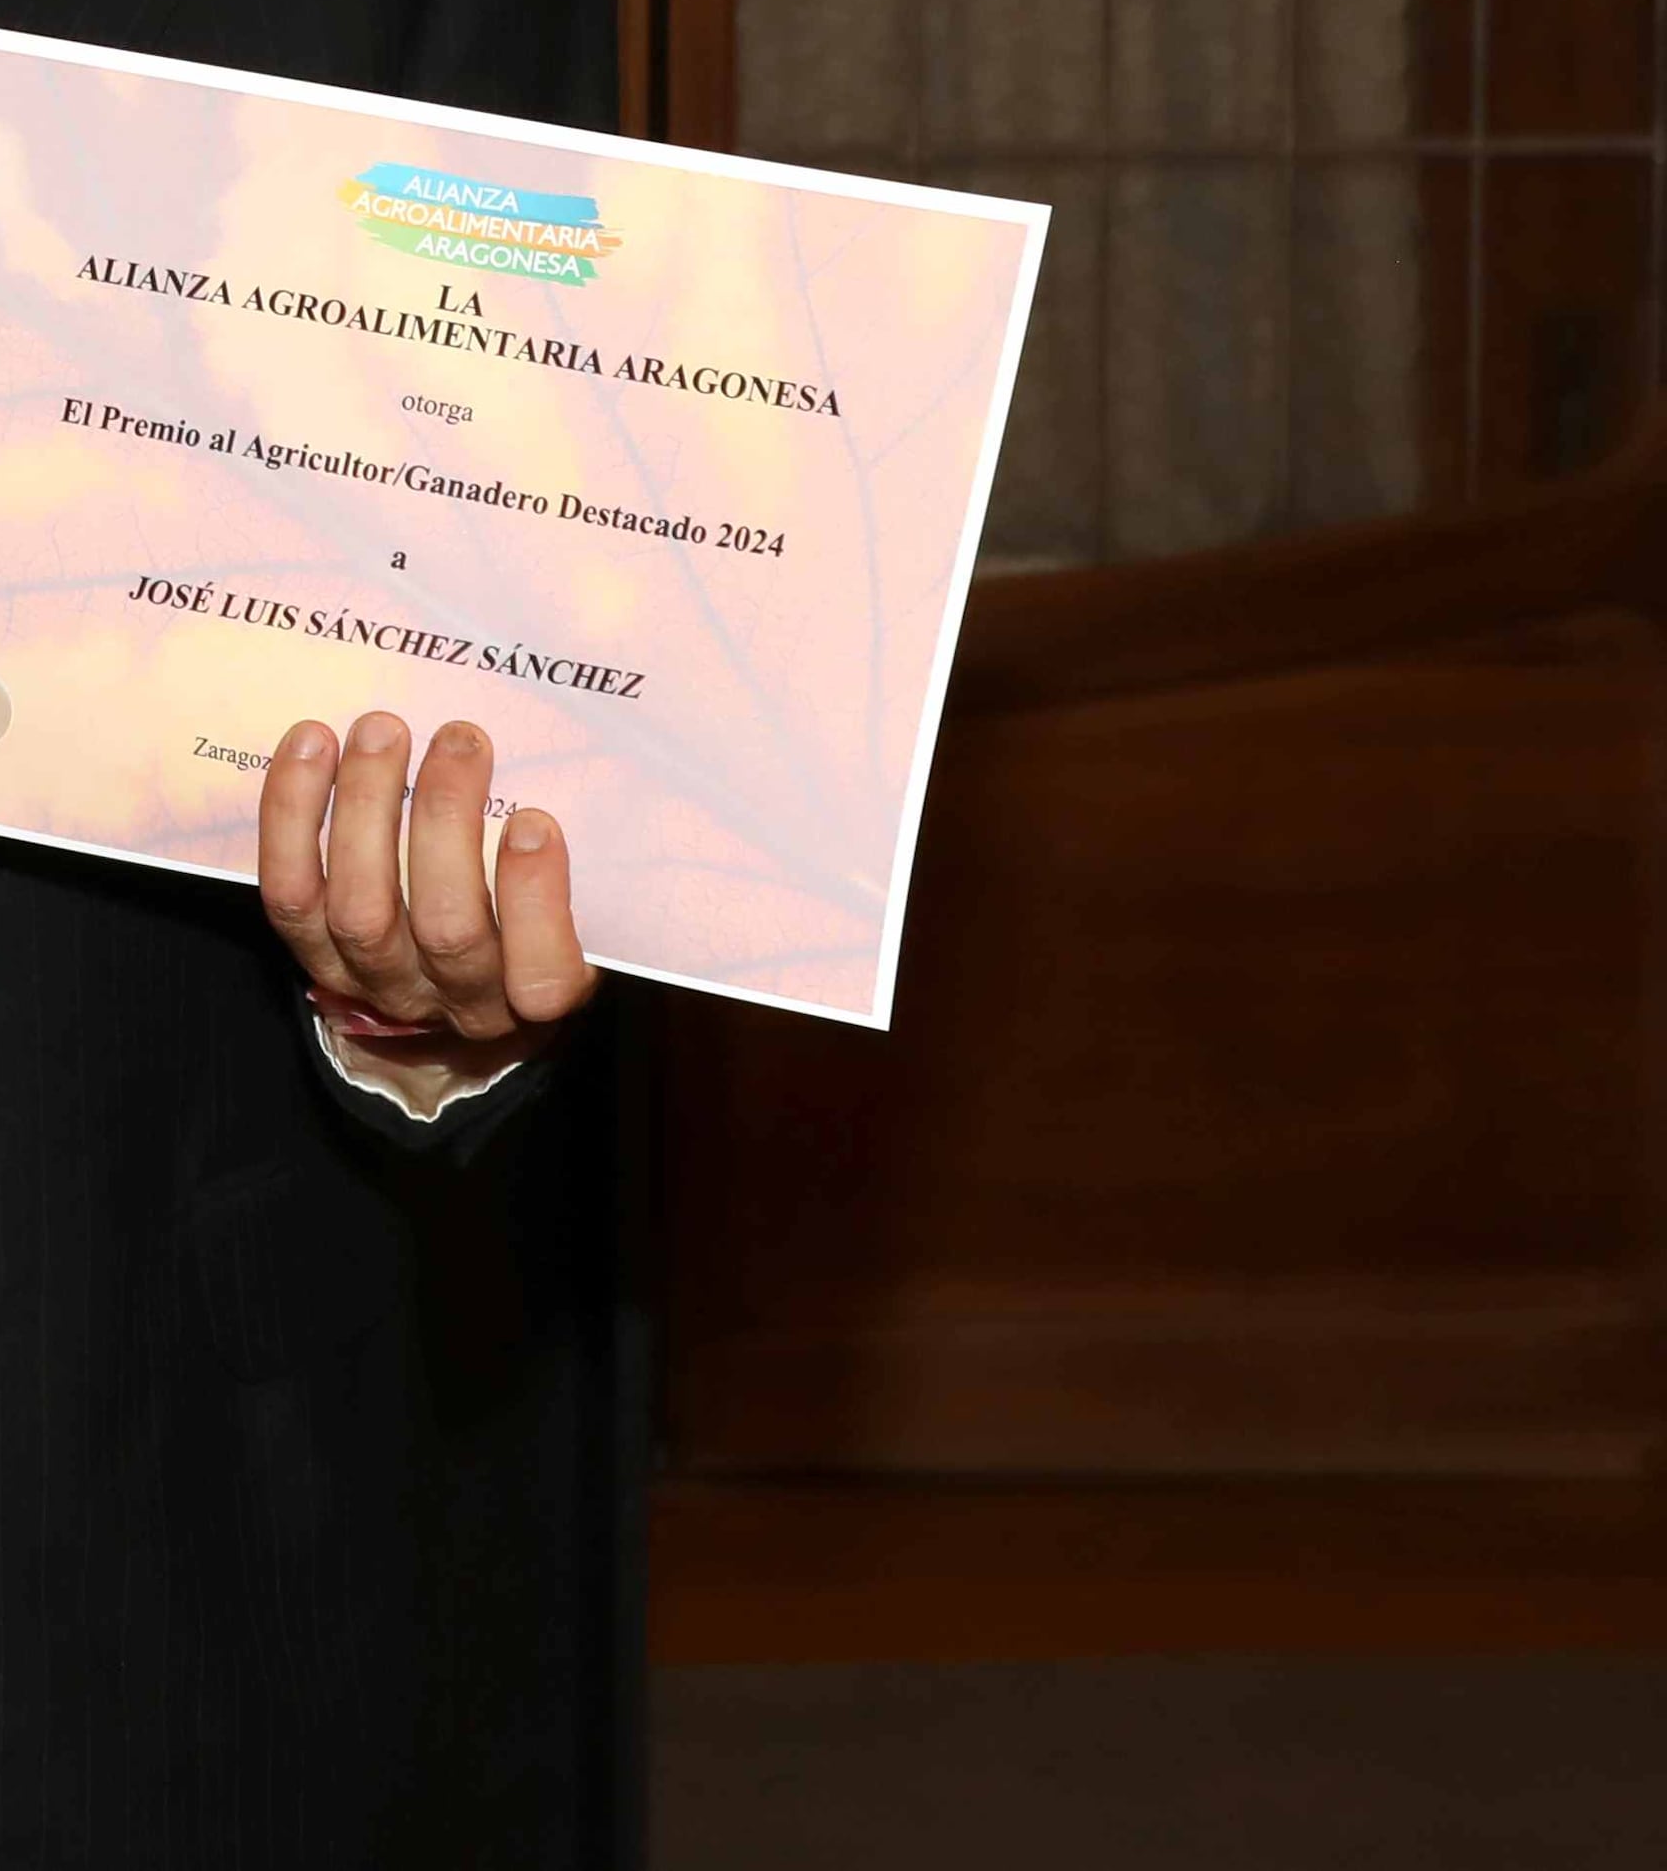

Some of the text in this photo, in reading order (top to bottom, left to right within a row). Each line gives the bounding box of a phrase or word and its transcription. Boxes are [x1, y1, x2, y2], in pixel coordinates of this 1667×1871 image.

[403, 175, 519, 213] ALIANZA
[352, 191, 601, 251] AGROALIMENTARIA
[415, 233, 581, 277] ARAGONESA
[436, 284, 483, 317] LA
[76, 255, 842, 417] ALIANZA AGROALIMENTARIA ARAGONESA
[402, 394, 473, 425] otorga
[61, 397, 786, 558] El Premio al Agricultor/Ganadero Destacado 2024
[390, 550, 407, 570] a
[129, 575, 646, 700] JOSÉ LUIS SÁNCHEZ SÁNCHEZ
[193, 736, 517, 818] Zaragoz 024
